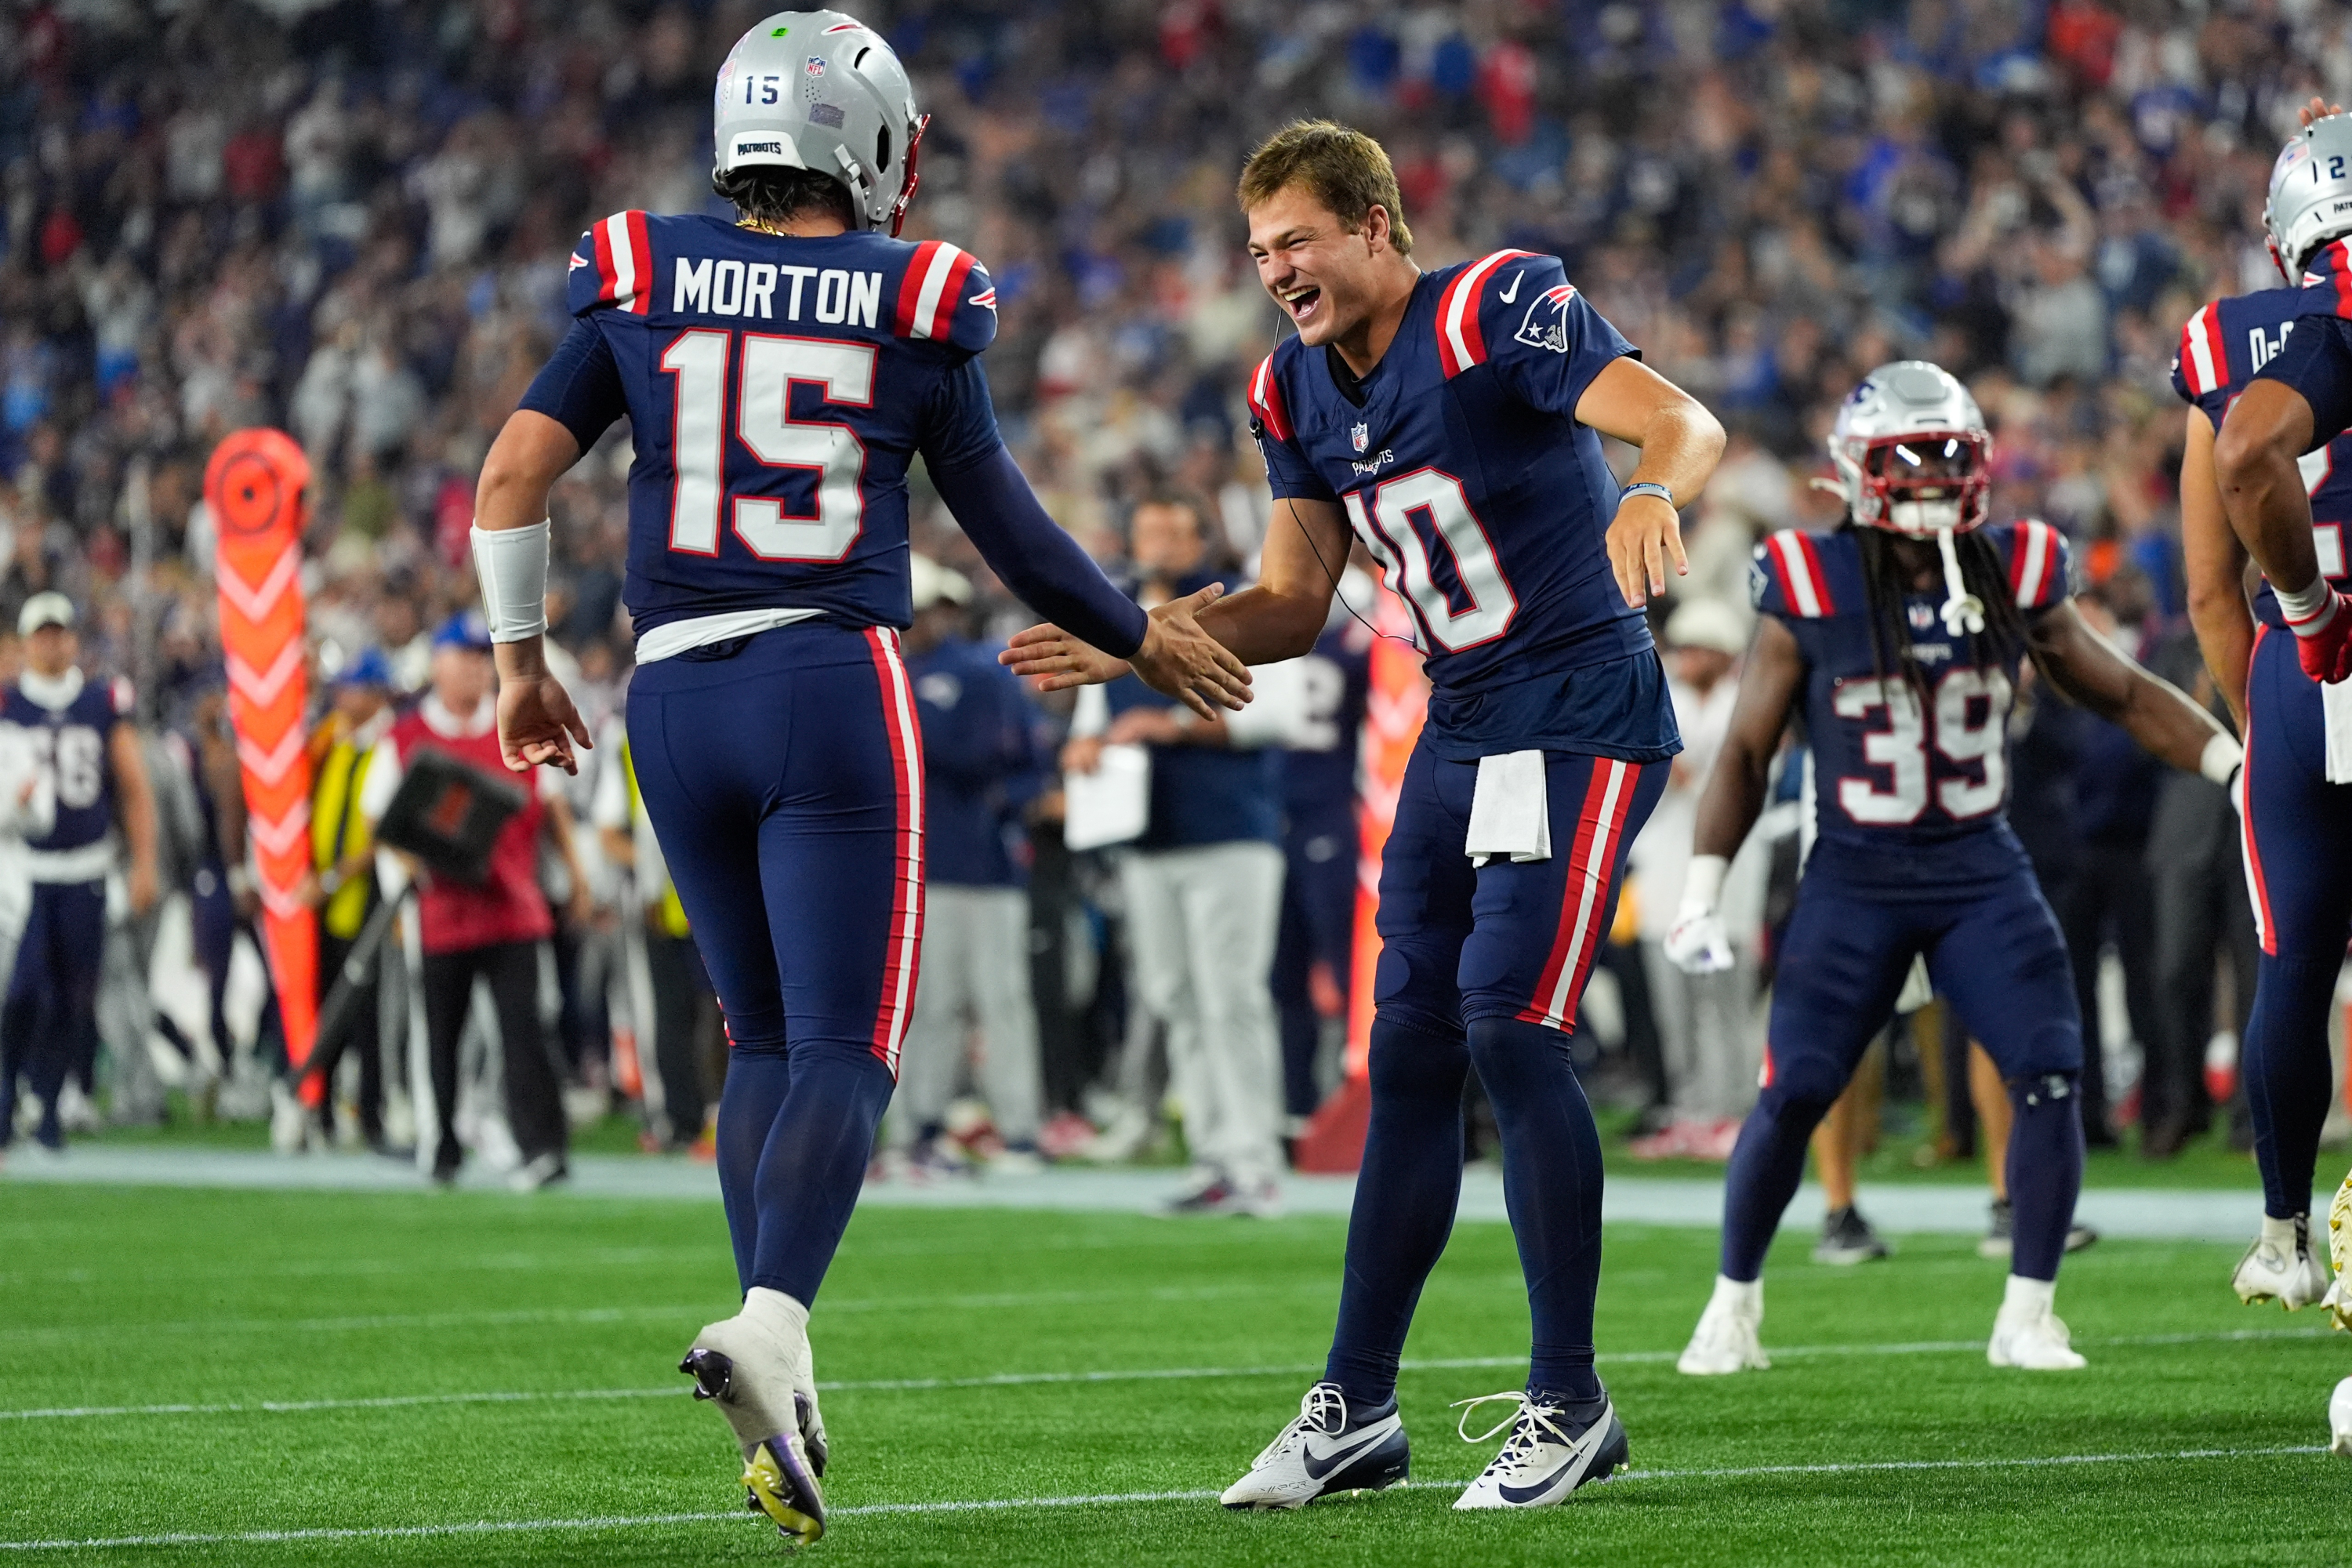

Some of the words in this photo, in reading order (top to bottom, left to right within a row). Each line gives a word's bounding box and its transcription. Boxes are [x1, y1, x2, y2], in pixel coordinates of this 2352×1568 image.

[746, 75, 780, 105] 15
[808, 64, 824, 75] NFL
[737, 141, 782, 156] PATRIOTS
[673, 256, 883, 328] MORTON
[659, 327, 879, 564] 15
[1355, 436, 1367, 448] NFL
[1342, 465, 1519, 657] 10
[1833, 664, 2013, 826] 39
